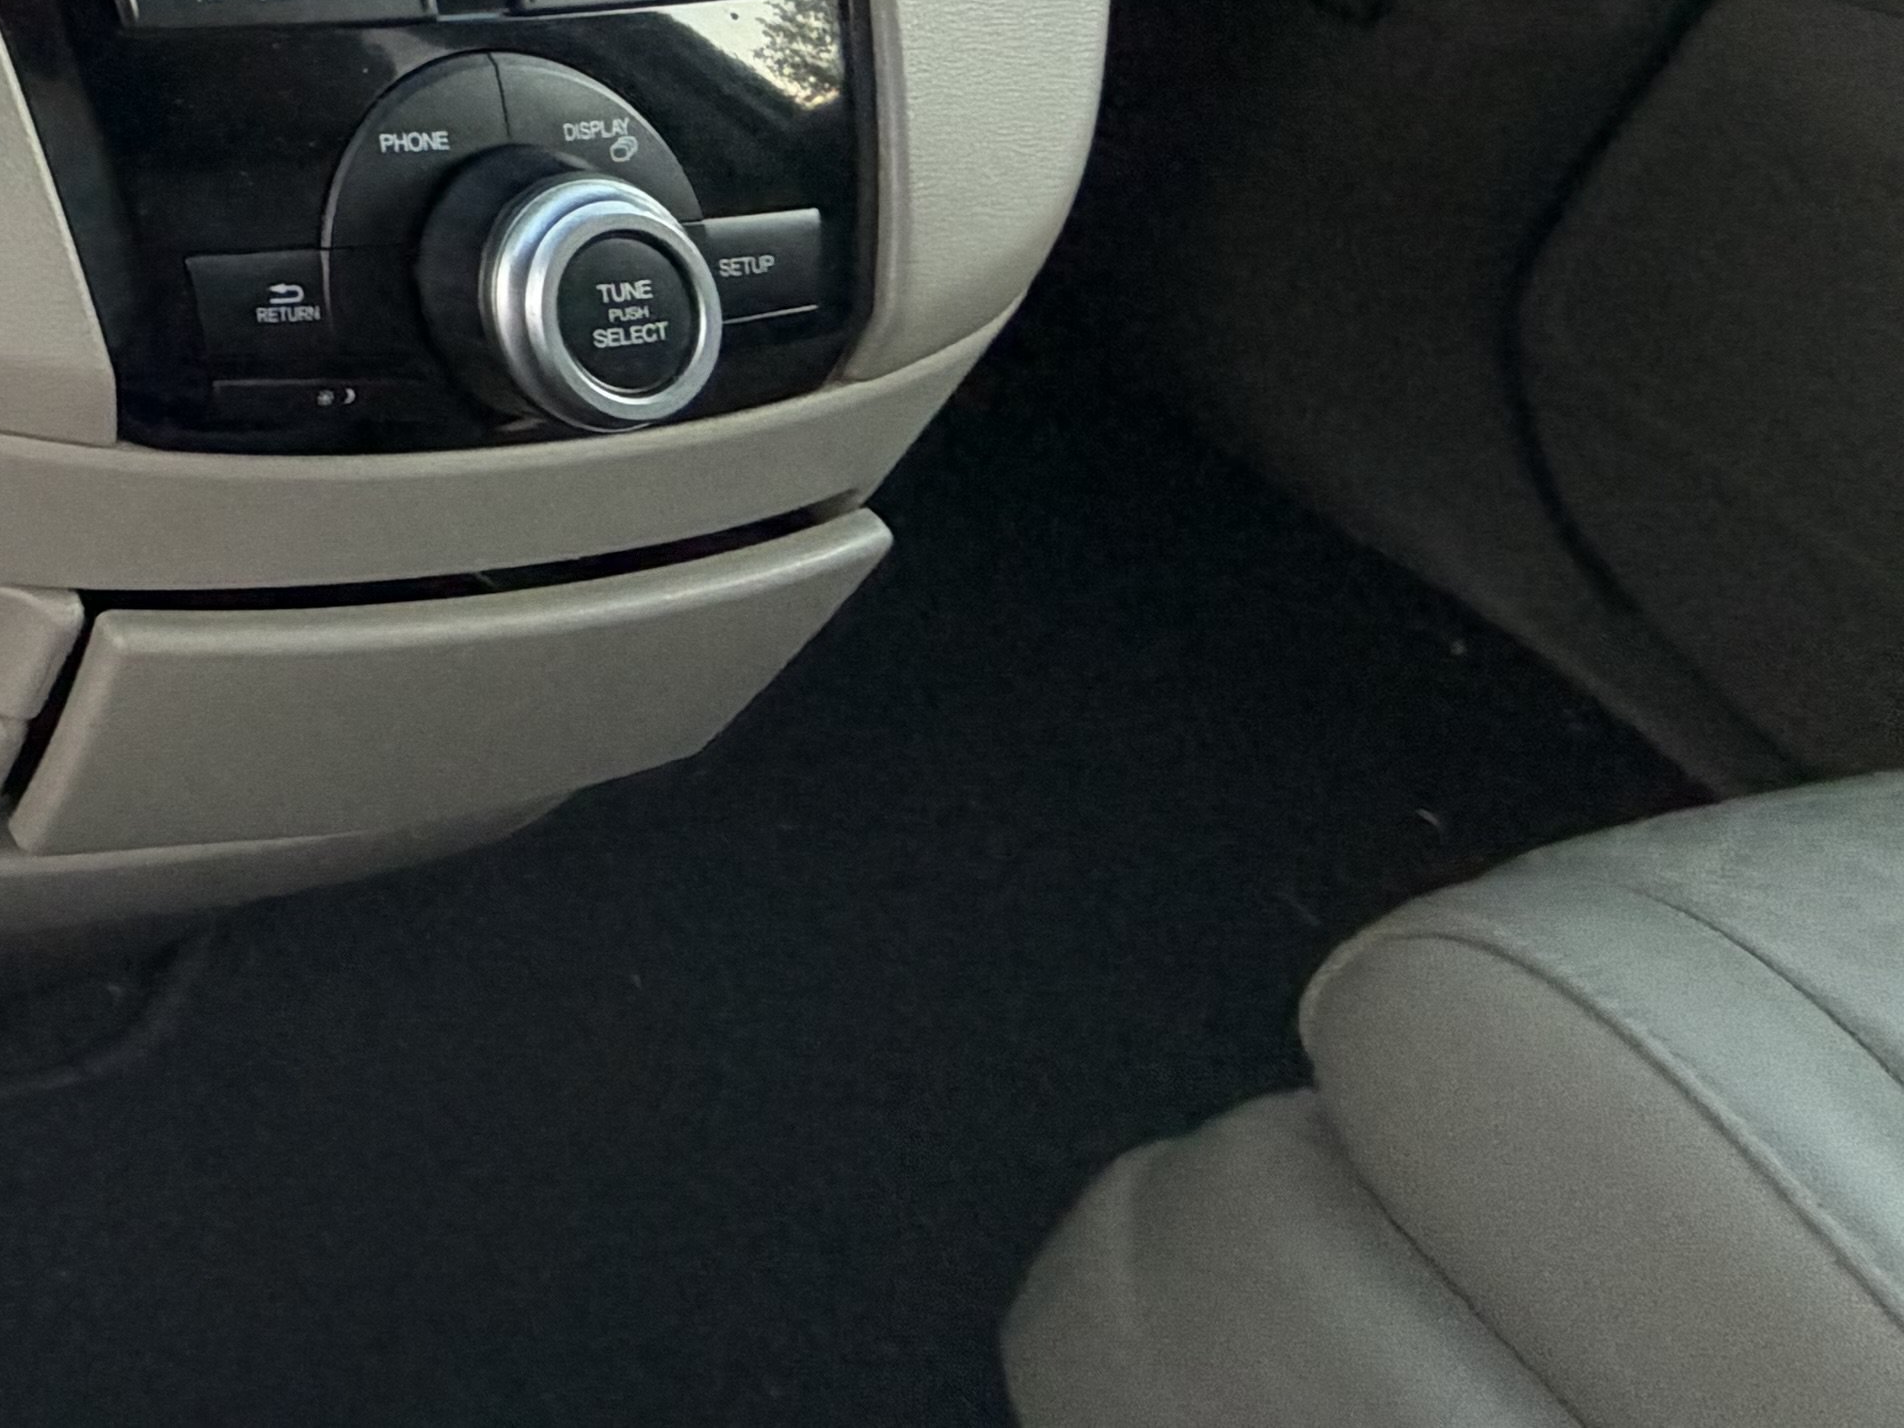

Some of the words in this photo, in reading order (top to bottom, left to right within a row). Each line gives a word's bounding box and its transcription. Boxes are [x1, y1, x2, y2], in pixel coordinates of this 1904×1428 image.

[378, 130, 450, 154] PHONE
[562, 118, 630, 142] DISPLAY
[718, 254, 775, 279] SETUP
[596, 279, 653, 303] TUNE
[255, 304, 321, 324] RETURN
[607, 304, 650, 322] PUSH
[591, 321, 669, 347] SELECT
